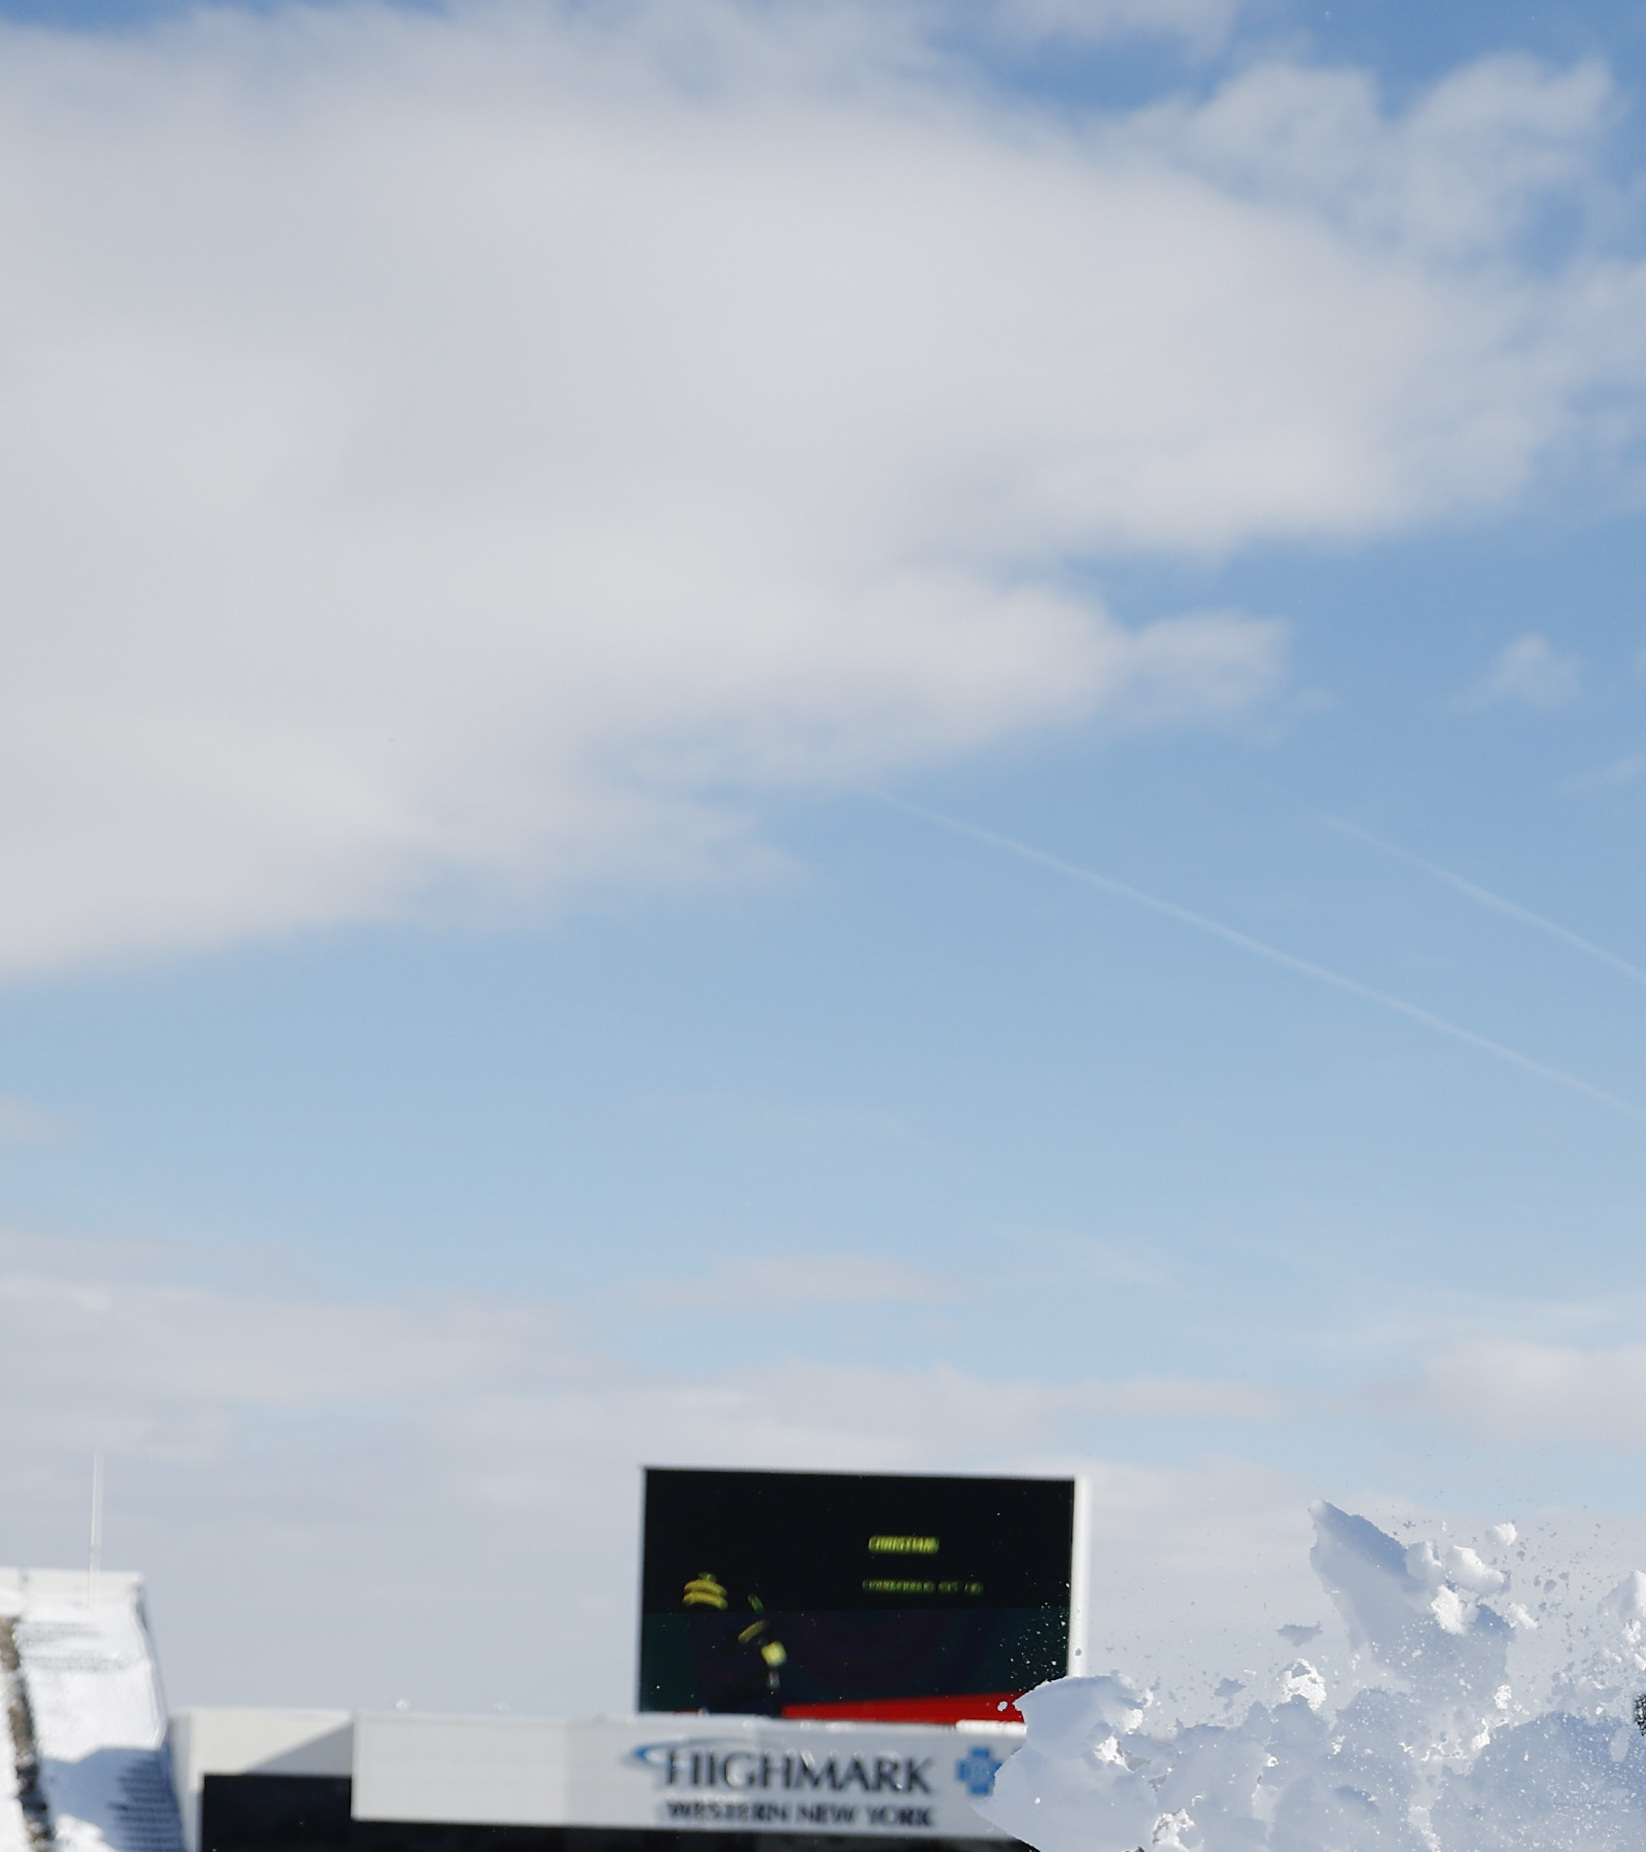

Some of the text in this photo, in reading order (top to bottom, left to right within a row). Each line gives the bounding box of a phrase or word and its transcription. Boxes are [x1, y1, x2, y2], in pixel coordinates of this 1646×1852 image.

[667, 1749, 934, 1796] HIGHMARK
[667, 1799, 934, 1829] WESTERN NEW YORK
